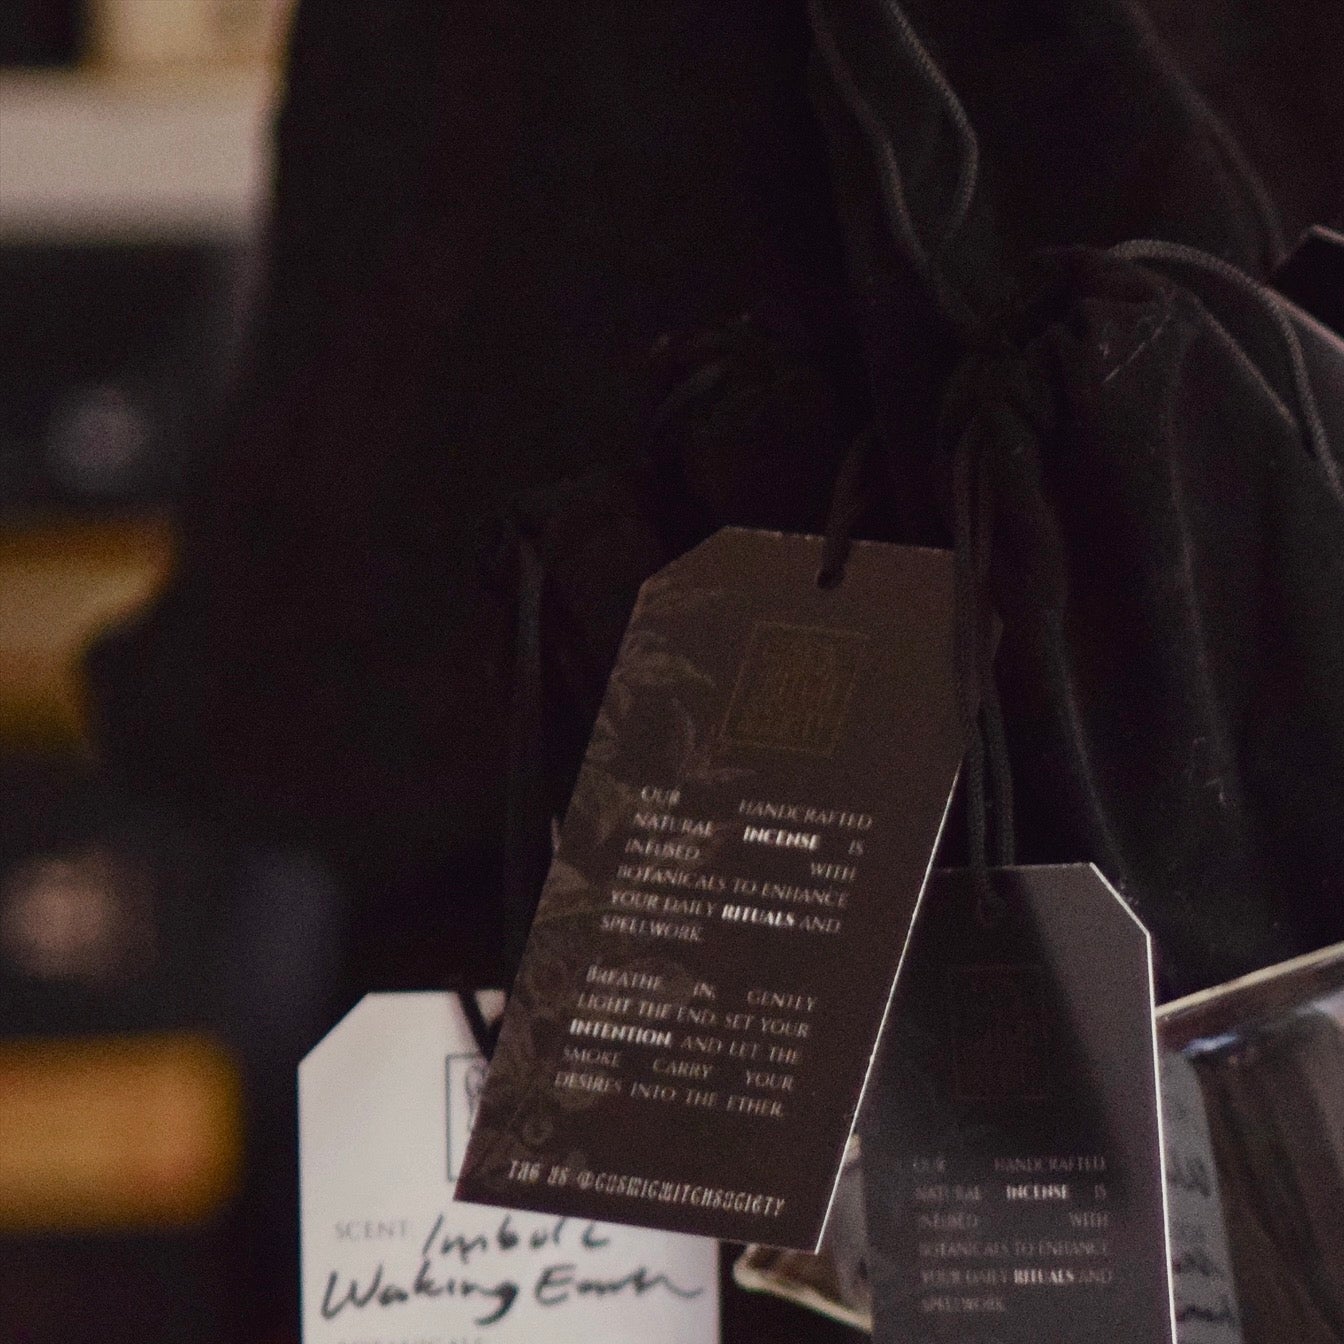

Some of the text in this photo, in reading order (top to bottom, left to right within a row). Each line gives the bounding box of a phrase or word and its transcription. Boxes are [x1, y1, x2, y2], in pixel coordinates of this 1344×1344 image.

[739, 800, 872, 830] HANDCRAFTED
[632, 812, 864, 856] NATURAL INCENSE IS
[625, 838, 857, 881] INFUSED WITH
[616, 864, 849, 908] BOTANICALS TO ENHANCE
[611, 889, 842, 934] YOUR DAILY RITUALS AND
[577, 993, 631, 1015] LIGHT
[638, 1000, 673, 1020] THE
[724, 1013, 754, 1030] SET
[760, 1016, 811, 1039] YOUR
[747, 989, 819, 1012] GENTLY
[680, 1036, 722, 1054] AND
[729, 1040, 761, 1059] LET
[769, 1046, 800, 1065] THE
[652, 1058, 713, 1080] CARRY
[745, 1070, 794, 1092] YOUR
[630, 1081, 676, 1101] INTO
[685, 1088, 718, 1108] THE
[1006, 1183, 1068, 1201] INCENSE
[1013, 1268, 1075, 1285] RITUALS
